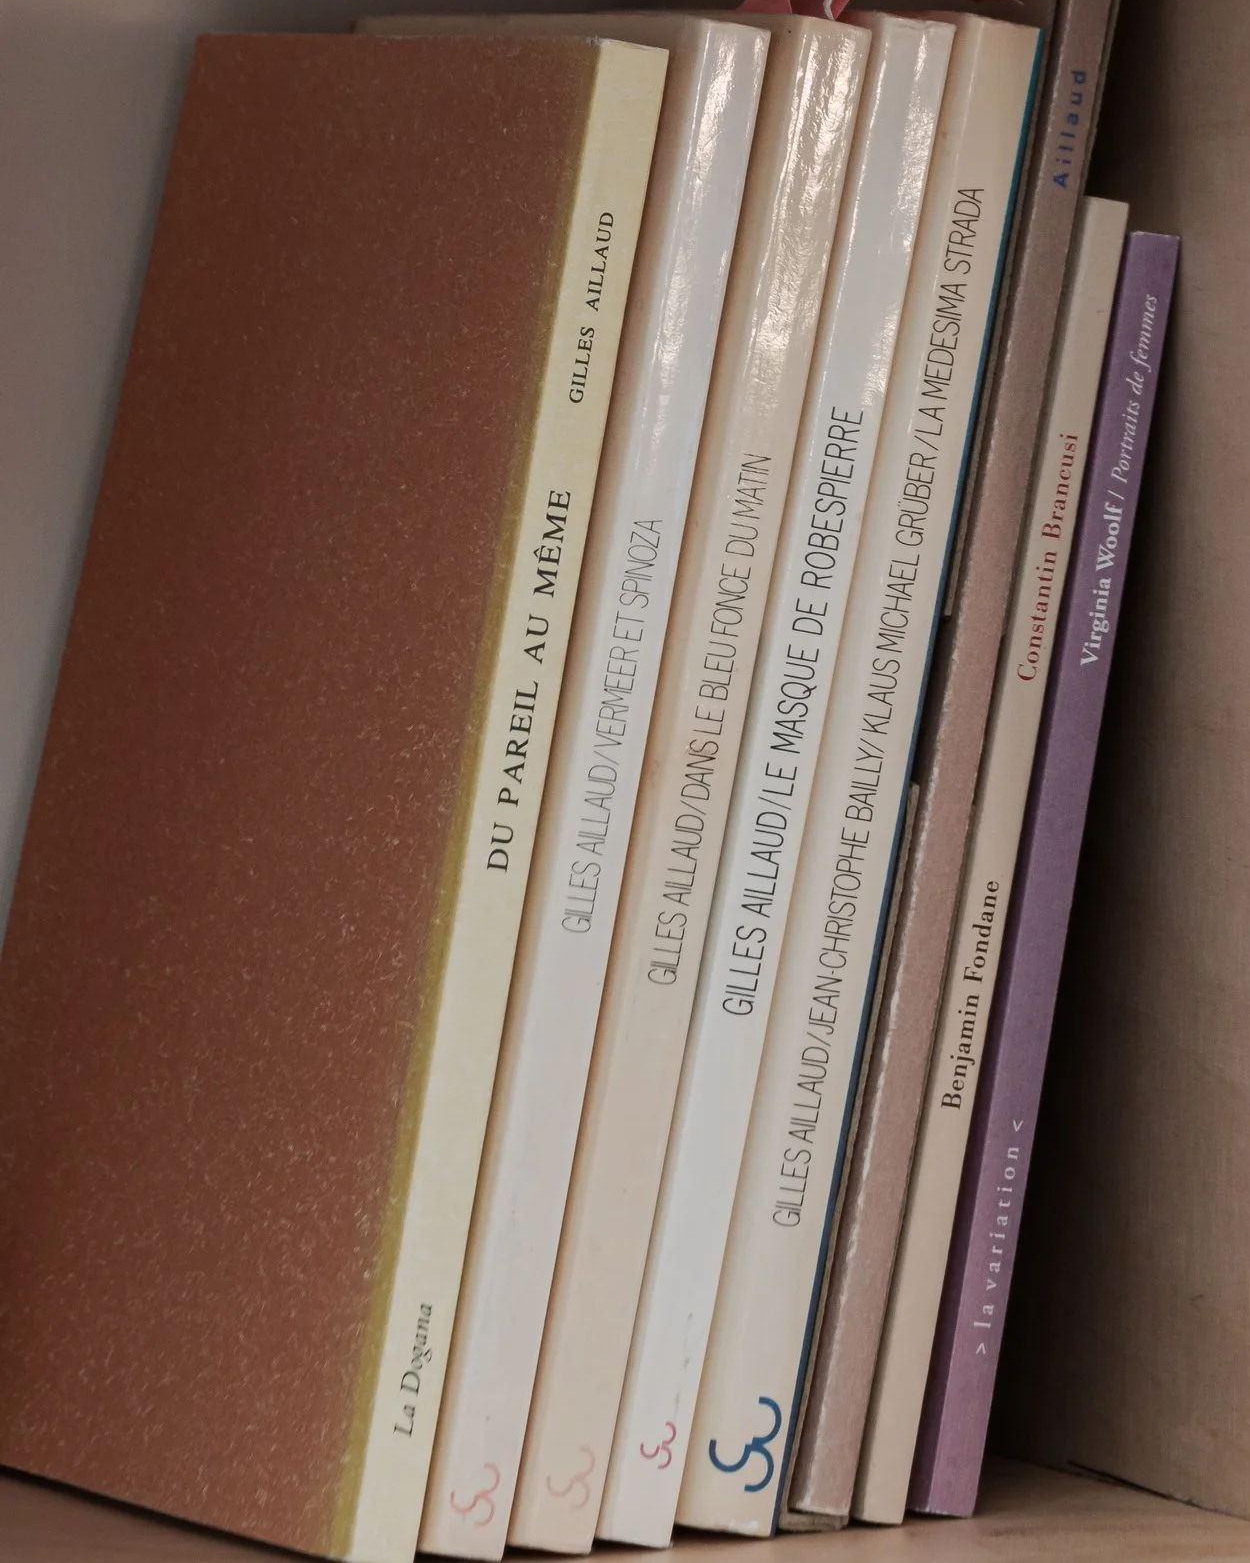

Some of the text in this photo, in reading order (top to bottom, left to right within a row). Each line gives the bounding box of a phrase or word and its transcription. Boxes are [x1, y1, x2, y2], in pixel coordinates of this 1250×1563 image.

[1053, 70, 1086, 188] Aillaud
[569, 212, 614, 403] GILLES AILLAUD
[1129, 293, 1158, 374] femmes
[1128, 367, 1145, 395] de
[732, 453, 772, 519] MATIN
[1111, 399, 1142, 485] Portraits
[725, 522, 759, 557] DU
[800, 406, 864, 589] ROBESPIERRE
[1095, 501, 1126, 572] Woolf
[619, 519, 664, 609] SPINOZA
[1017, 432, 1079, 682] Constantin Brancusi
[613, 611, 645, 642] ET
[791, 597, 828, 635] DE
[1080, 576, 1111, 667] Virginia
[486, 489, 571, 874] DU PAREIL AU MÊME
[699, 640, 737, 701] BLEU
[770, 644, 820, 754] MASQUE
[773, 1145, 812, 1228] GILLES
[876, 553, 920, 654] MICHAEL
[921, 283, 967, 400] MEDESIMA
[944, 188, 985, 275] STRADA
[693, 705, 725, 736] LE
[562, 859, 601, 934] GILLES
[647, 910, 687, 985] GILLES
[722, 924, 767, 1016] GILLES
[941, 880, 999, 1110] Benjamin Fondane
[974, 1304, 994, 1328] la
[986, 1146, 1020, 1291] variation
[393, 1302, 432, 1438] La Dogana
